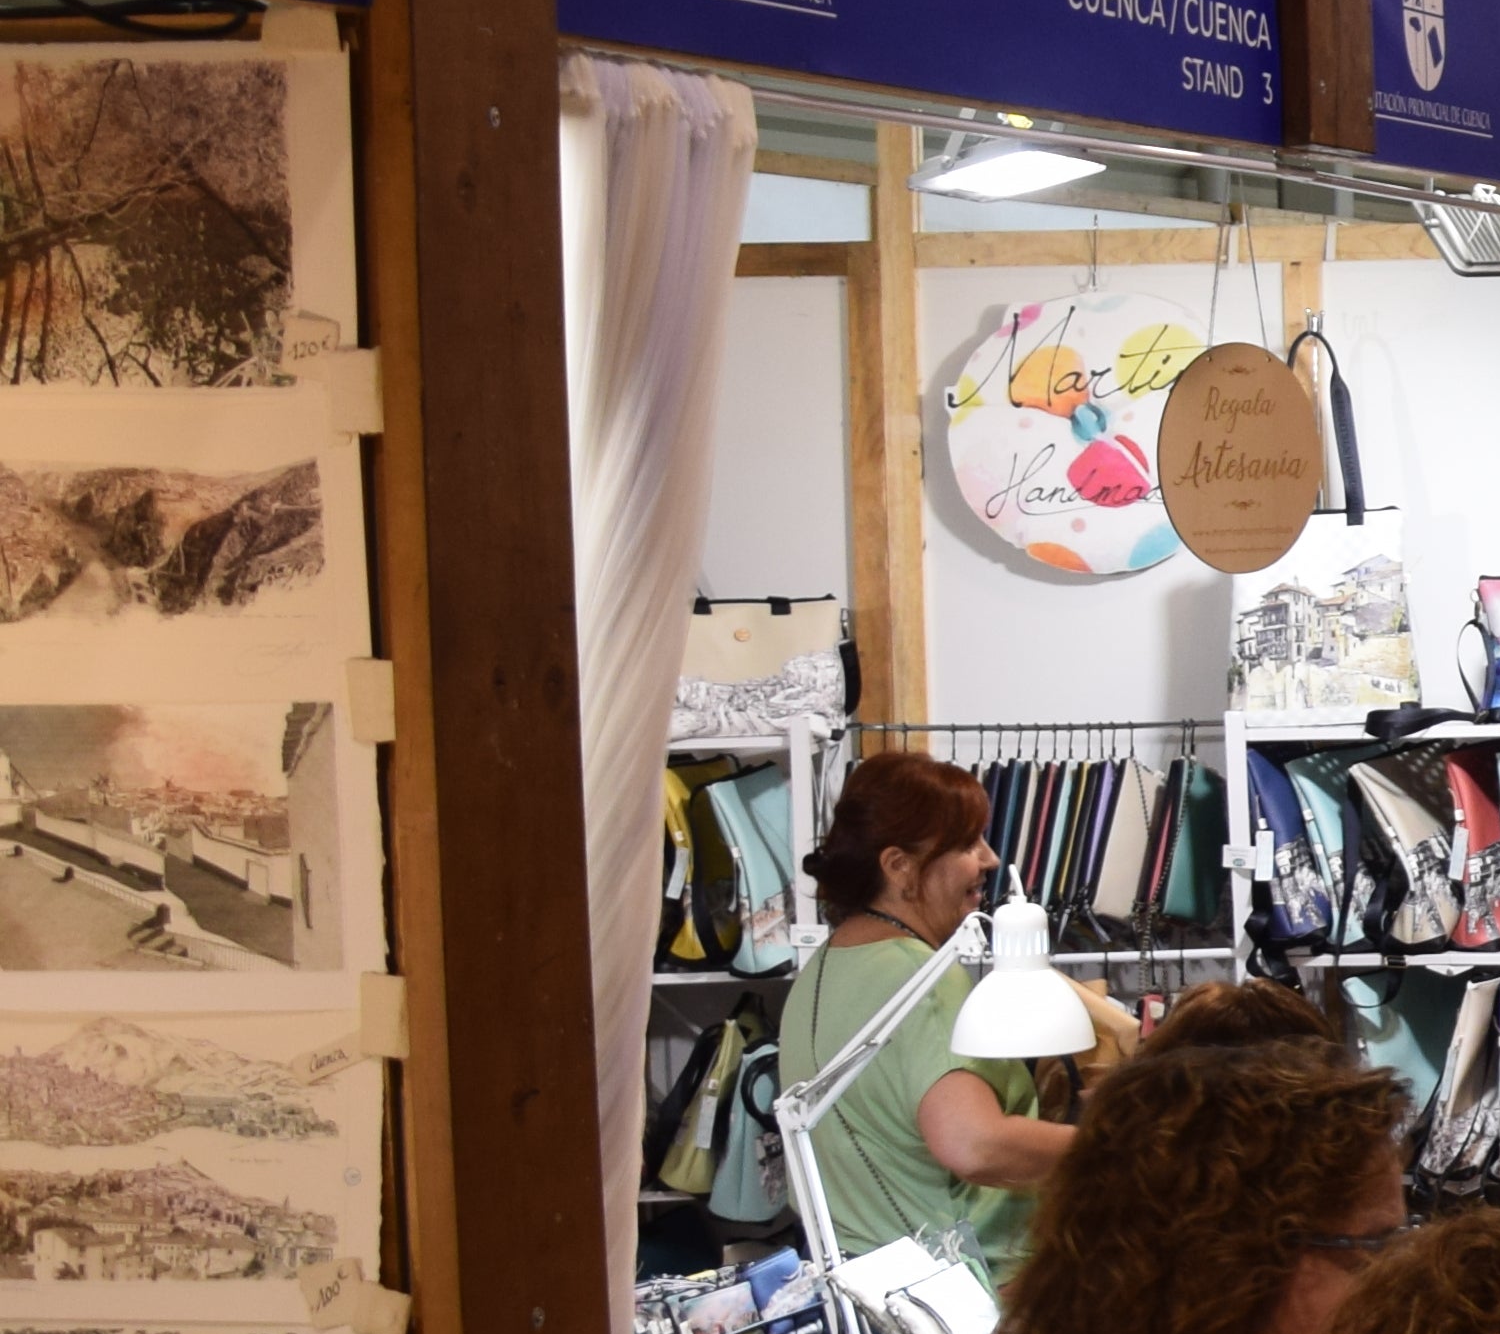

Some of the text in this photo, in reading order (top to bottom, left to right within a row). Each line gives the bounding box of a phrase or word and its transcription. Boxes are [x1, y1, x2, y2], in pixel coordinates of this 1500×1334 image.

[1182, 57, 1273, 104] STAND 3
[947, 305, 1205, 408] Marti
[1204, 385, 1276, 434] Regala
